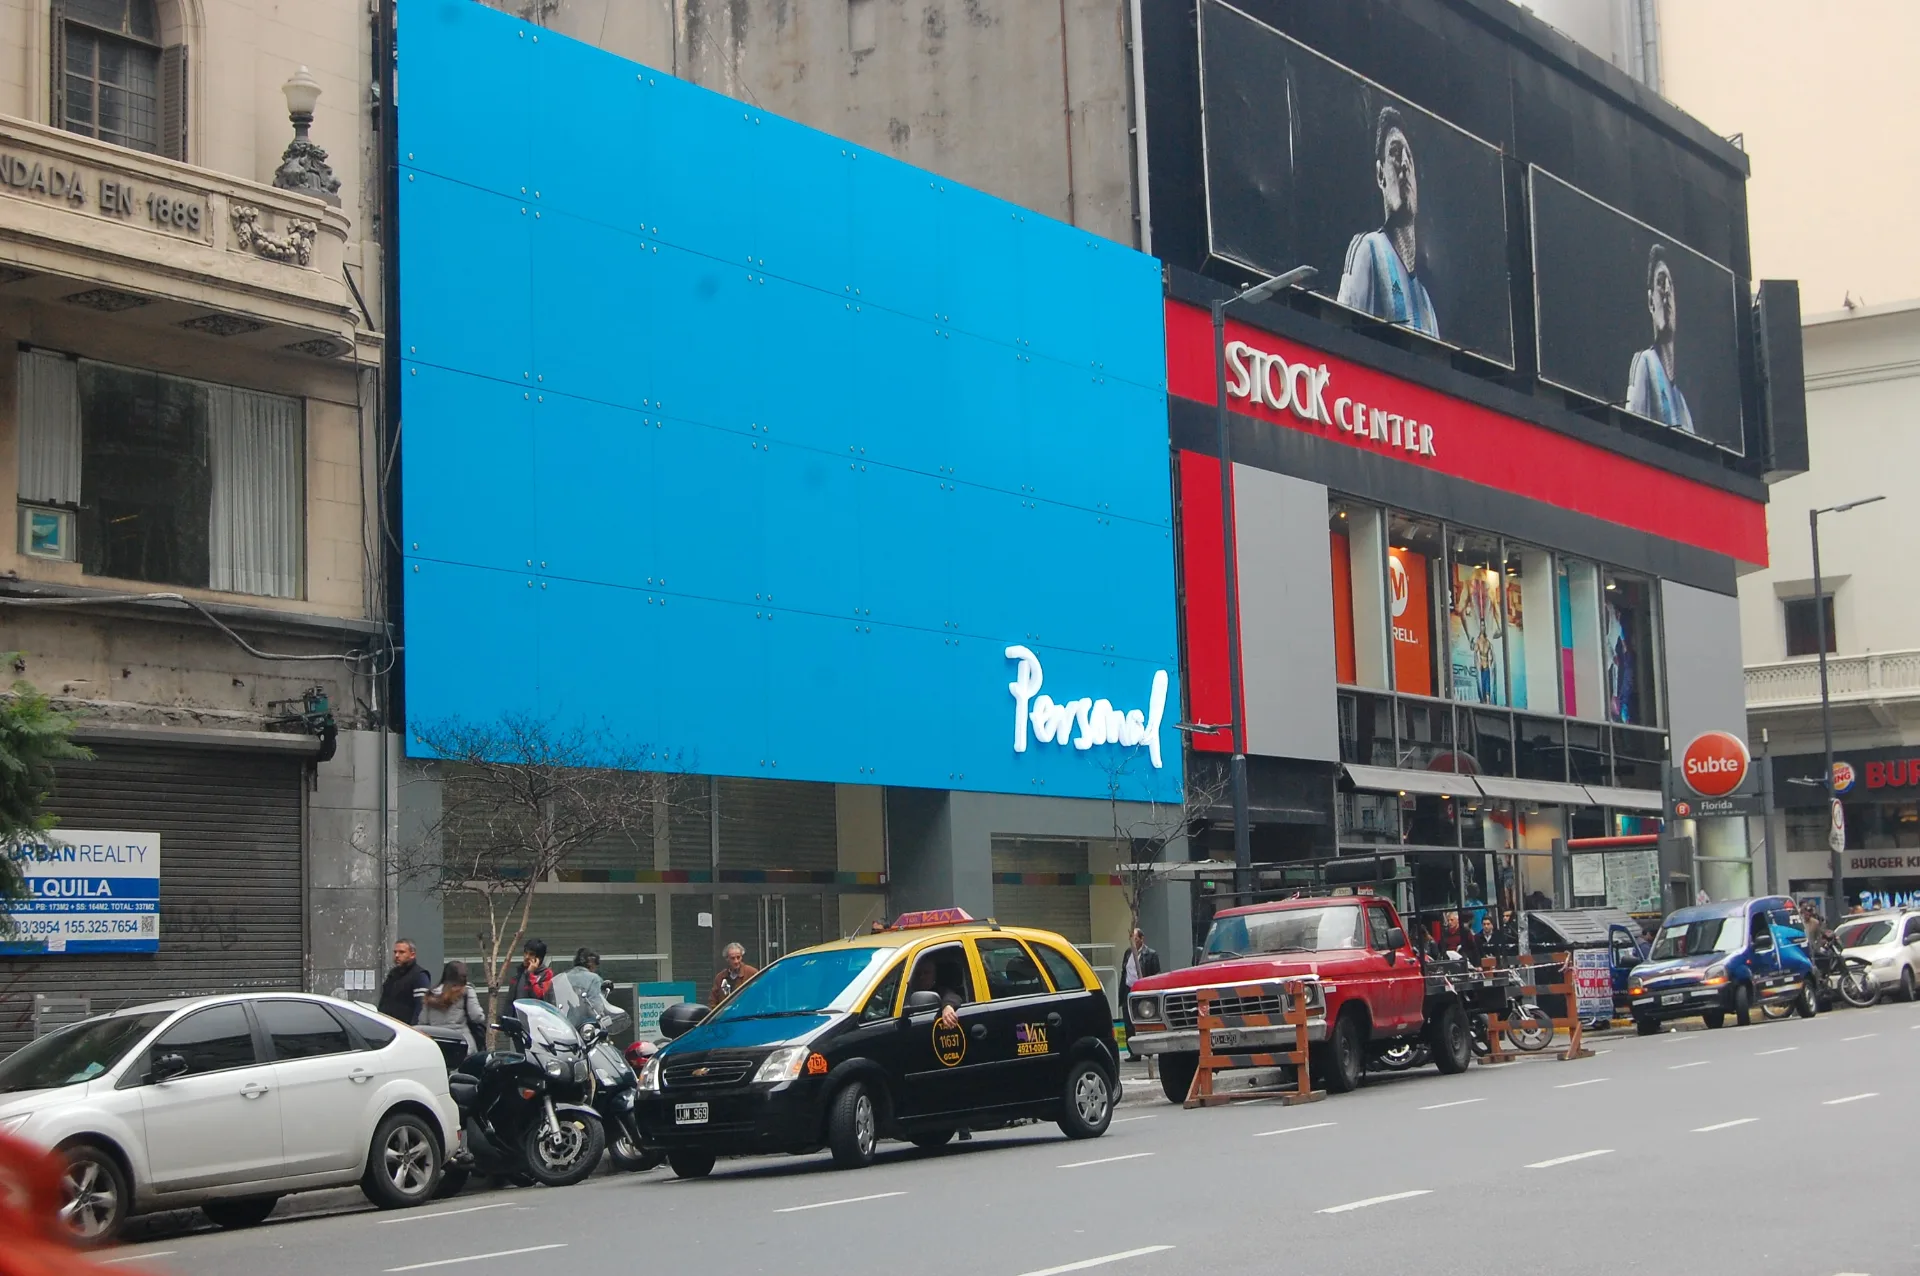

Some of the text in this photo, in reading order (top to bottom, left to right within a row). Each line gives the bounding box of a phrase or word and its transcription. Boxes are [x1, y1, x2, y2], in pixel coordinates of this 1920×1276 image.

[99, 178, 134, 215] EN
[147, 192, 200, 230] 1889
[1225, 341, 1437, 457] STOCK CENTER
[1005, 645, 1169, 768] Personal
[1687, 756, 1738, 774] Subte
[1679, 806, 1686, 815] B
[1701, 800, 1733, 810] Florida
[7, 843, 148, 863] URBAN REALTY
[1851, 857, 1903, 869] BURGER
[28, 879, 112, 897] LQUILA
[35, 903, 48, 911] PB:
[75, 903, 87, 911] SS:
[111, 903, 134, 911] TOTAL:
[922, 910, 955, 922] VAN
[64, 919, 138, 934] 155.325.7654
[640, 1001, 665, 1009] estamos
[1025, 1022, 1047, 1042] VAN
[940, 1034, 959, 1048] 11637
[943, 1052, 959, 1060] GCBA
[676, 1107, 708, 1120] JJM 969
